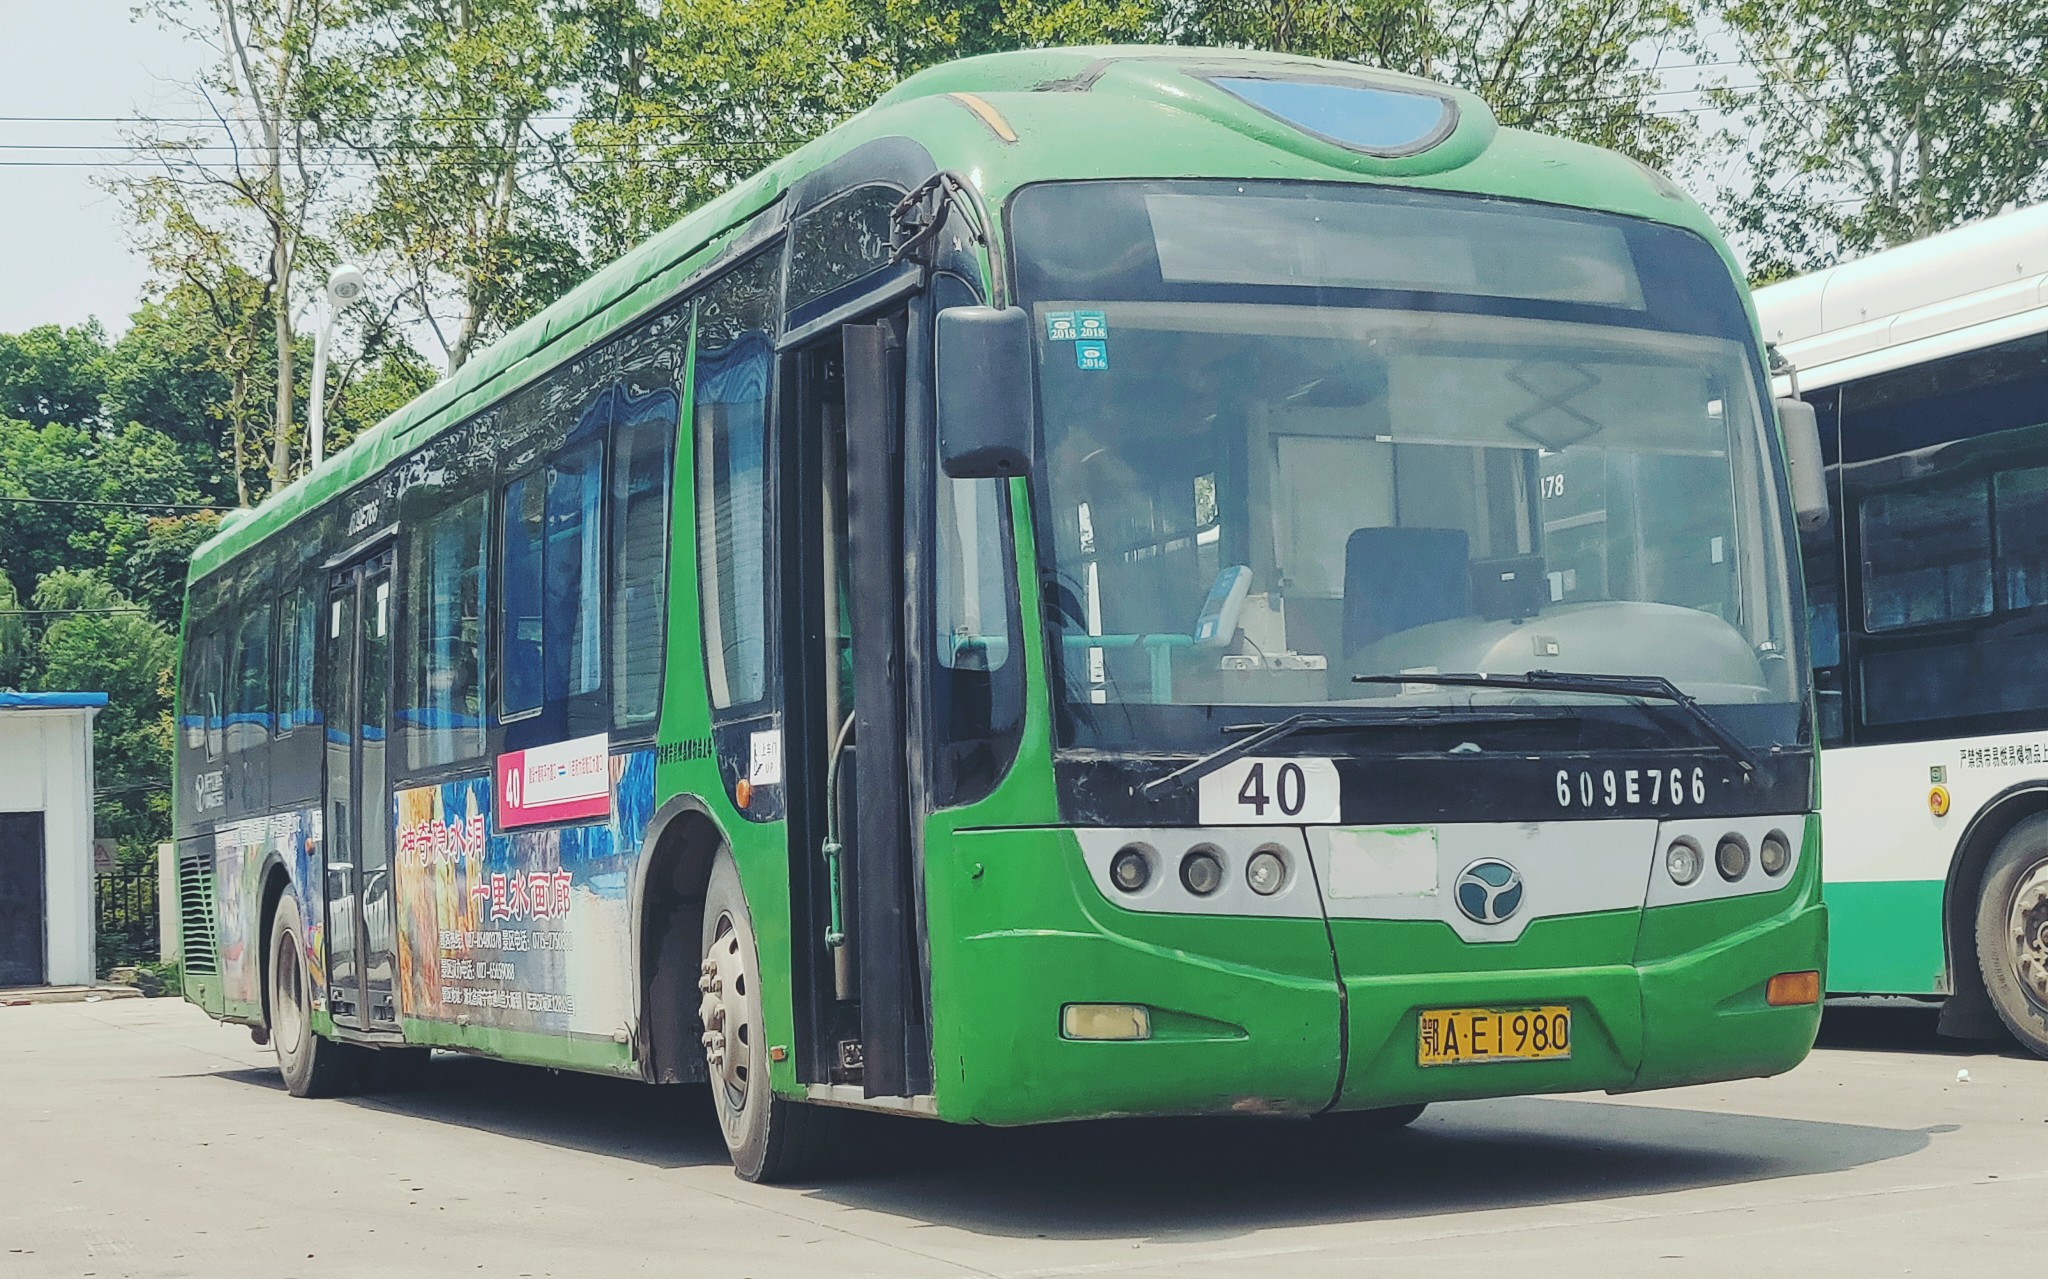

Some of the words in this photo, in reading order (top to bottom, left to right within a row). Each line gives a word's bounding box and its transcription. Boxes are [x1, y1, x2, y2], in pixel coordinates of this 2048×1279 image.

[1051, 328, 1075, 338] 2018
[1081, 327, 1105, 337] 2018
[1082, 359, 1105, 367] 2016
[505, 767, 520, 809] 40
[1238, 762, 1306, 816] 40
[1556, 767, 1705, 807] 609E766
[399, 813, 486, 868] 神奇隐水洞
[471, 865, 573, 923] 十里水画廊
